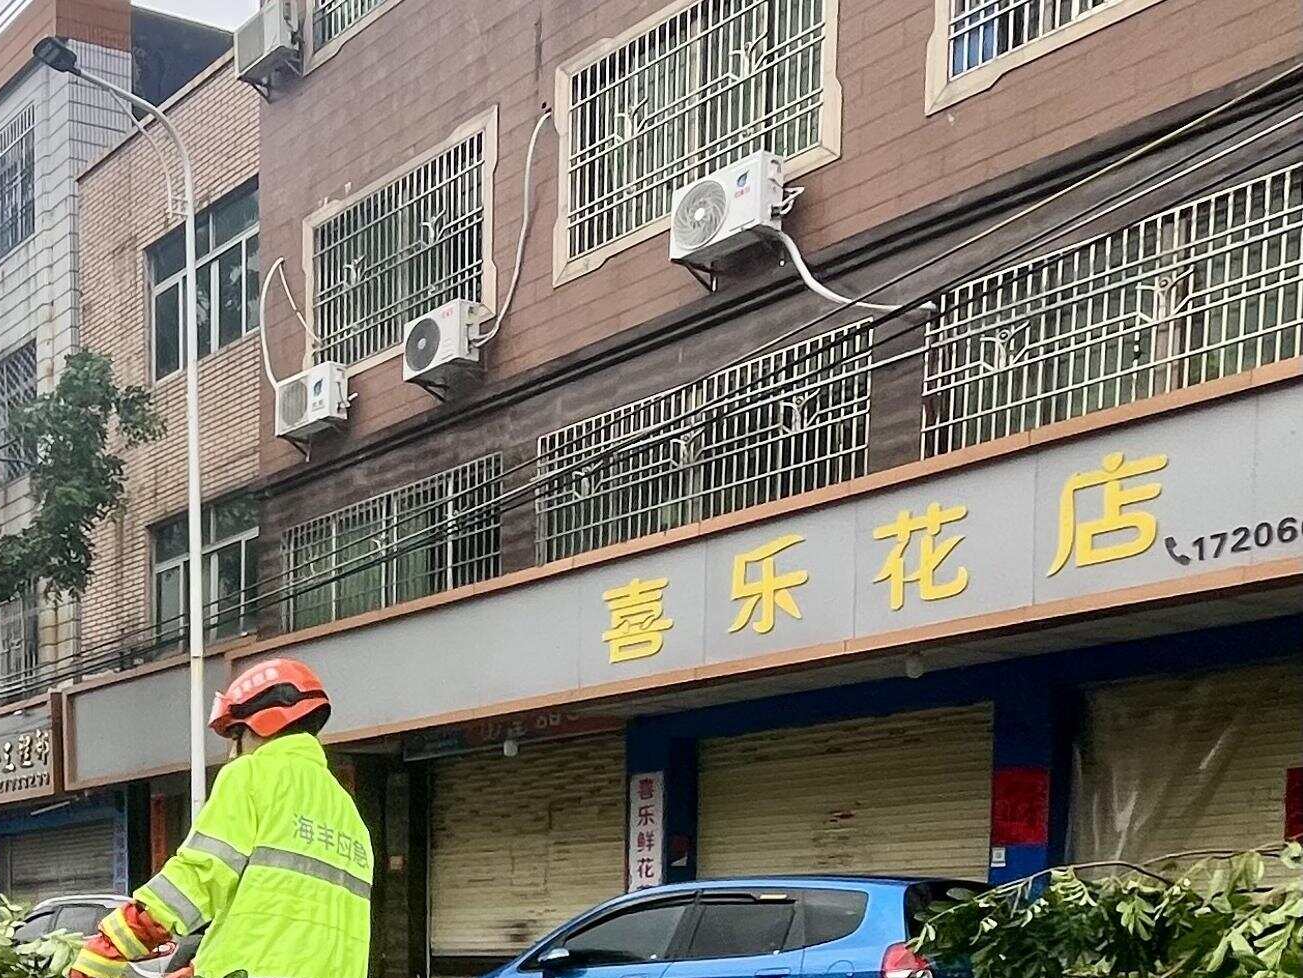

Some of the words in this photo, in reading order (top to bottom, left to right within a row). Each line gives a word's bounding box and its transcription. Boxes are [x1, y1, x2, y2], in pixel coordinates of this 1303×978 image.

[601, 451, 1169, 665] 喜乐花店
[1192, 517, 1303, 561] 17206
[636, 777, 656, 889] 喜乐鲜花
